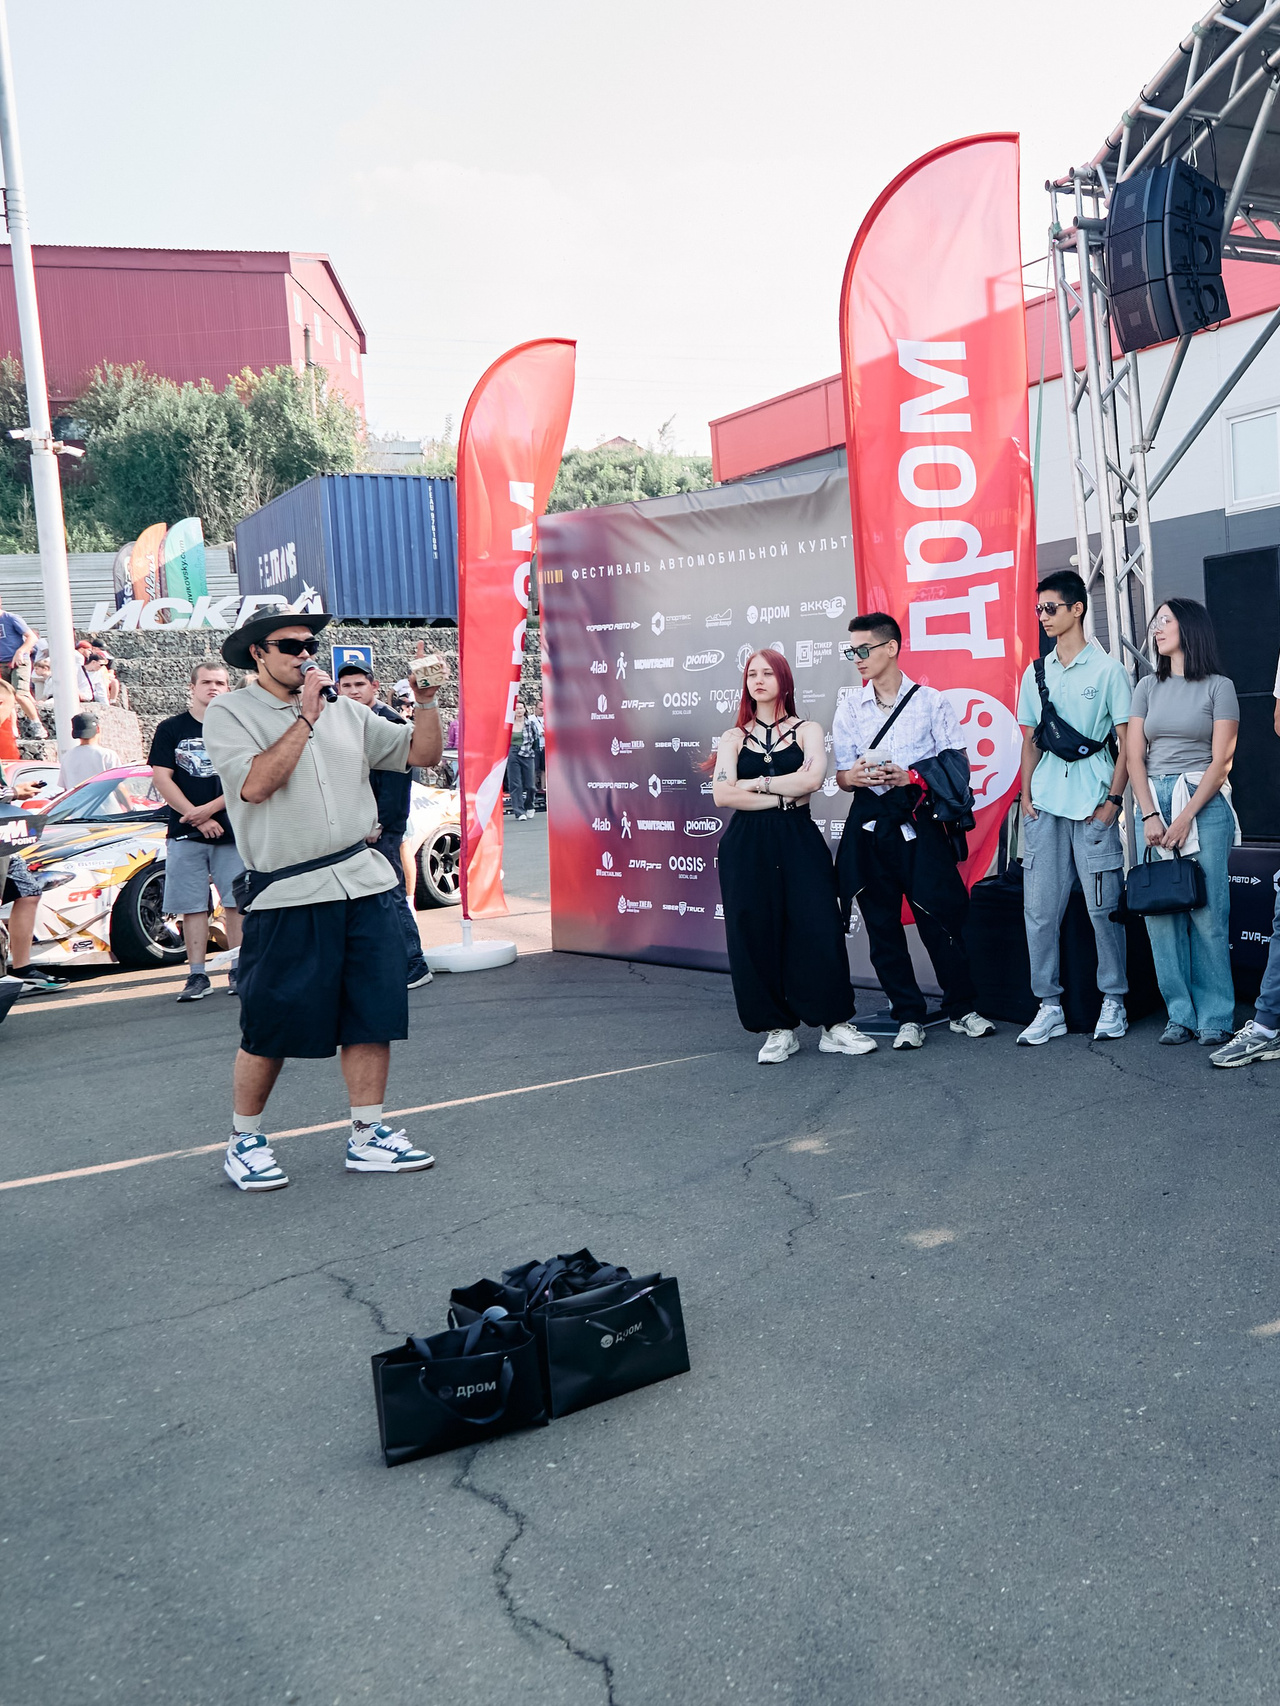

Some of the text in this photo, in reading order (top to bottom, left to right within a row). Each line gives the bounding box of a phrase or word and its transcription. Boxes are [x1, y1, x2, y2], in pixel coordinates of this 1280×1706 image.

[898, 338, 1015, 660] дром
[572, 563, 651, 580] ФЕСТИВАЛЬ
[659, 541, 789, 571] АВТОМОБИЛЬНОЙ
[760, 605, 790, 624] дром
[456, 1380, 496, 1399] дром
